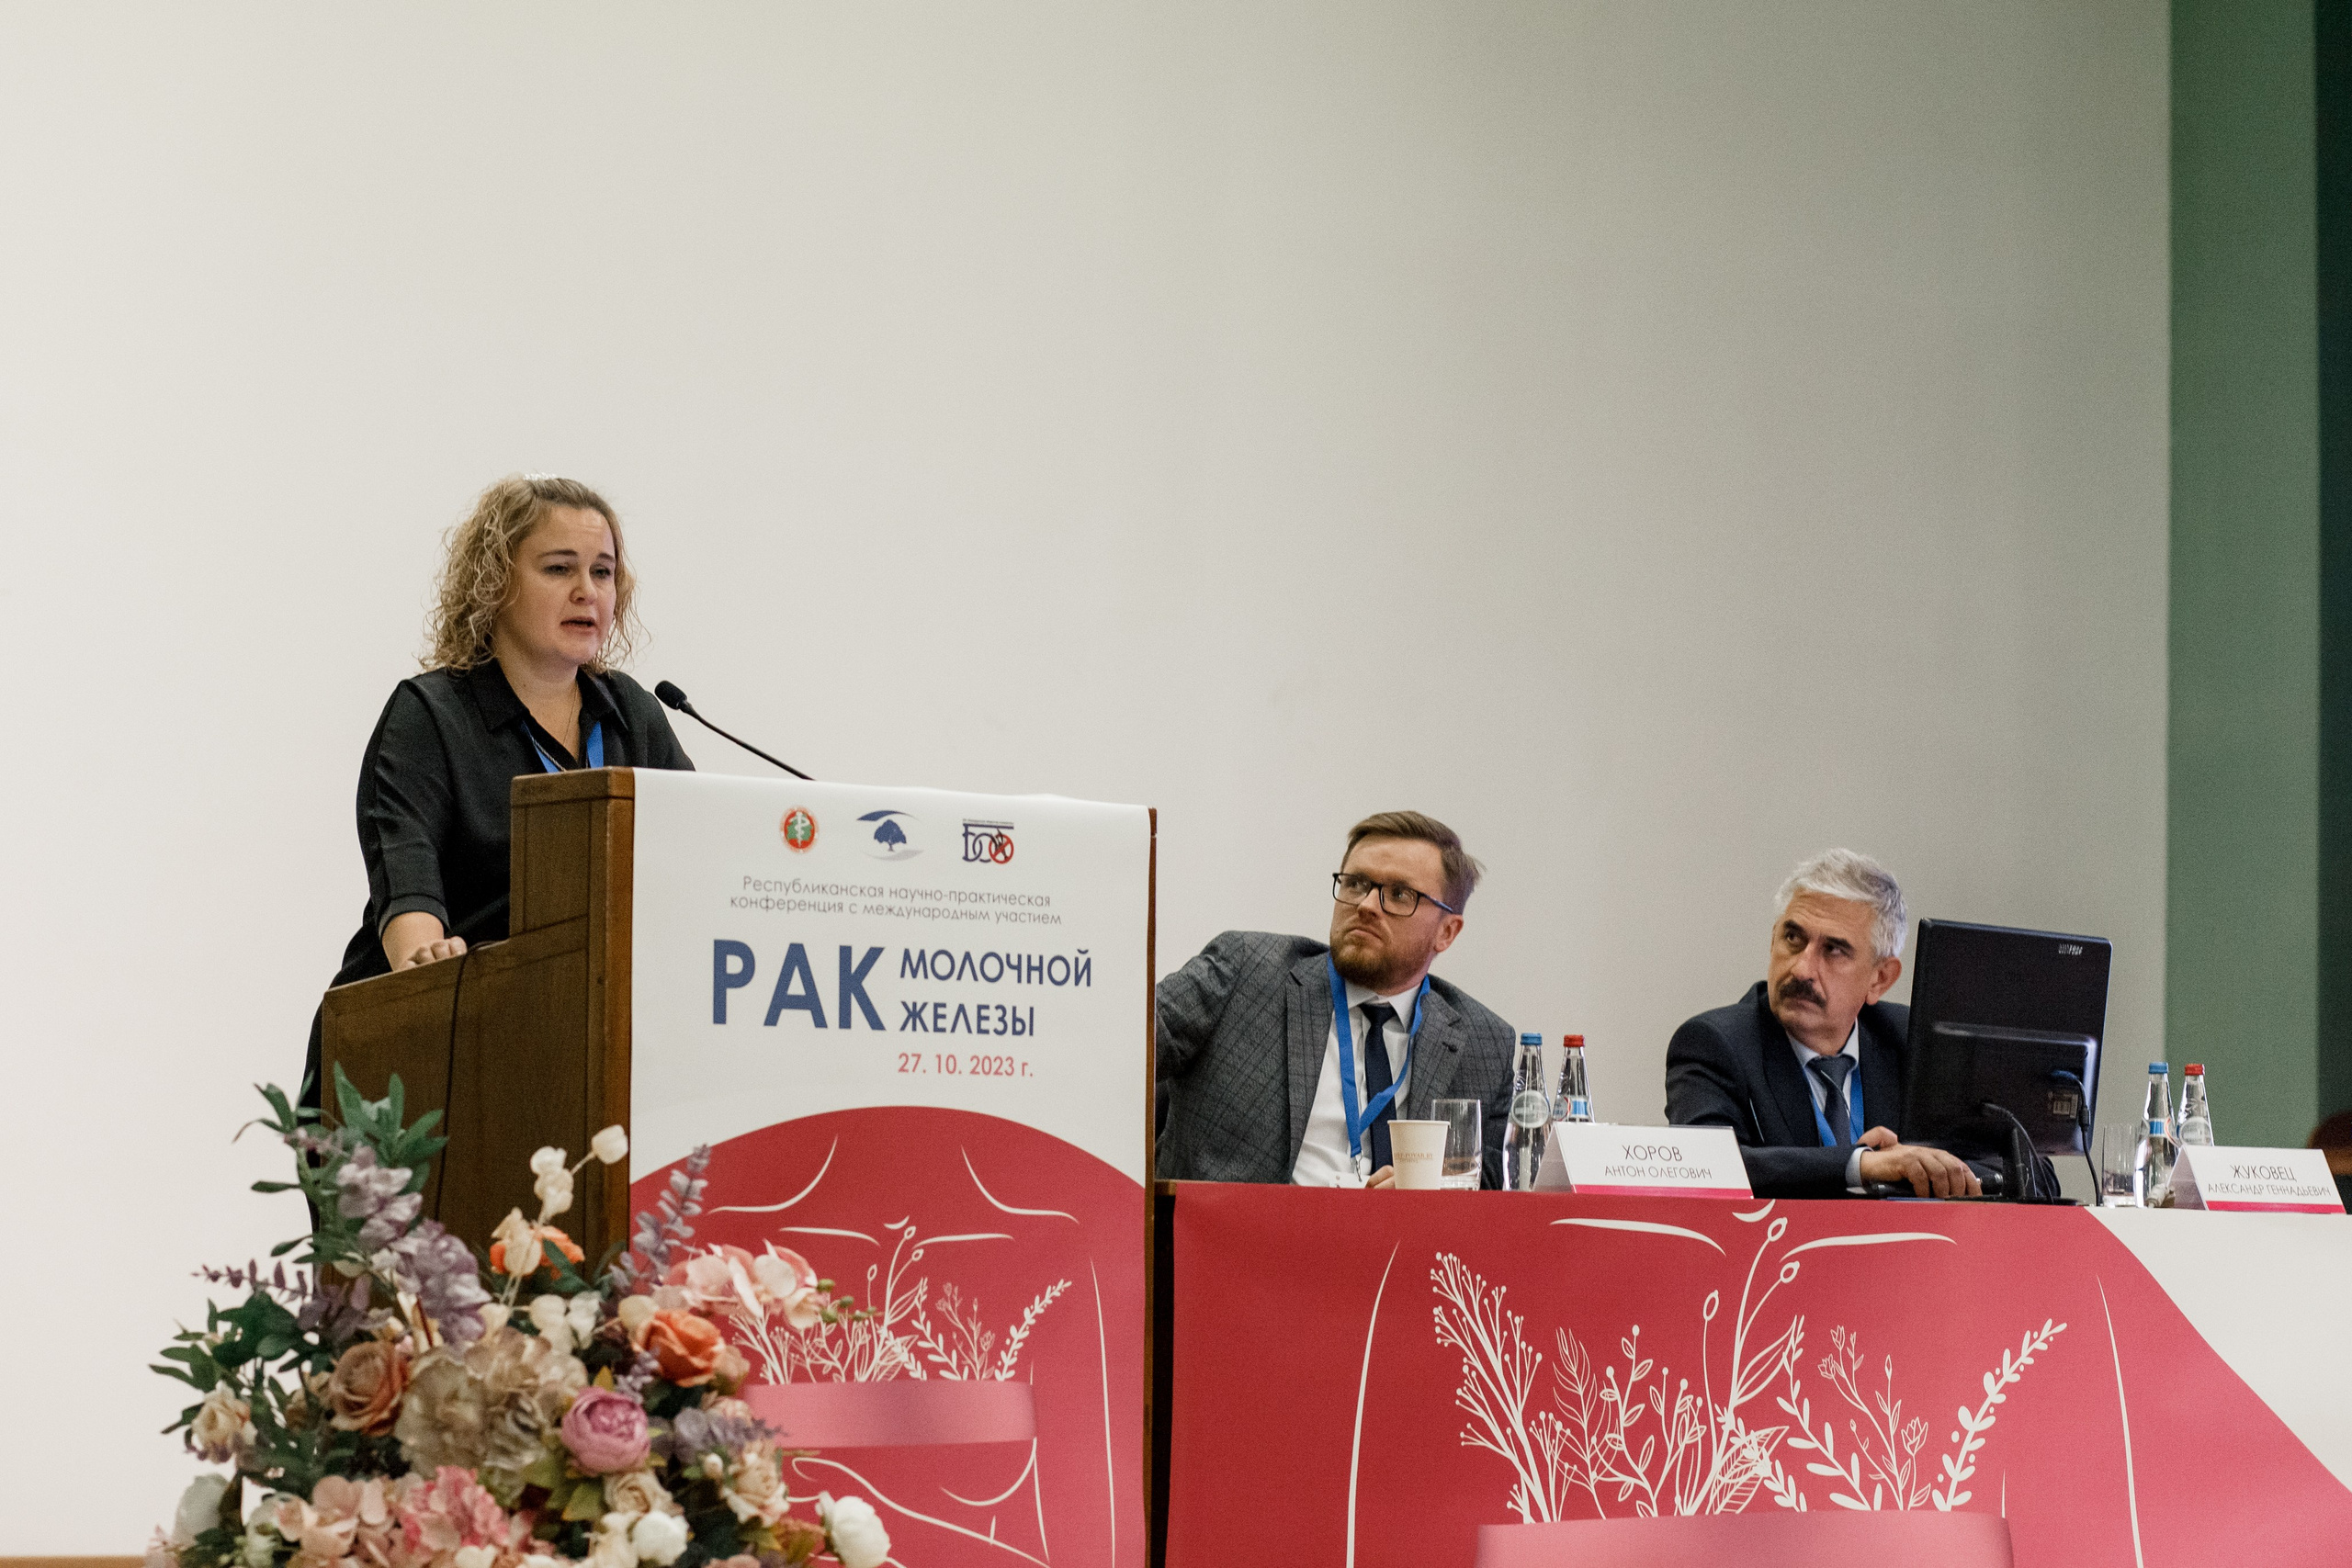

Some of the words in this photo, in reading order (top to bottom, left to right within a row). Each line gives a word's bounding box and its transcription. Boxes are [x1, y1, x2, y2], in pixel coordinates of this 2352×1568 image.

[742, 875, 884, 897] Республиканская
[889, 886, 1051, 907] научно-практическая
[730, 895, 843, 913] конференция
[849, 903, 857, 914] с
[862, 903, 990, 920] международным
[995, 912, 1062, 925] участием
[900, 948, 1091, 987] МОЛОЧНОЙ
[713, 939, 887, 1031] РАК
[899, 1000, 1035, 1036] ЖЕЛЕЗЫ
[898, 1052, 926, 1074] 27.
[935, 1054, 962, 1075] 10.
[969, 1055, 1015, 1077] 2023
[1021, 1061, 1034, 1077] г.
[1622, 1145, 1682, 1162] ХОРОВ
[1604, 1166, 1645, 1178] АНТОН
[1648, 1166, 1712, 1179] ОЛЕГОВИЧ
[2230, 1165, 2297, 1182] ЖУКОВЕЦ
[2208, 1182, 2265, 1196] АЛЕКСАНДР
[2267, 1184, 2332, 1198] ГЕННАДЬЕВИЧ
